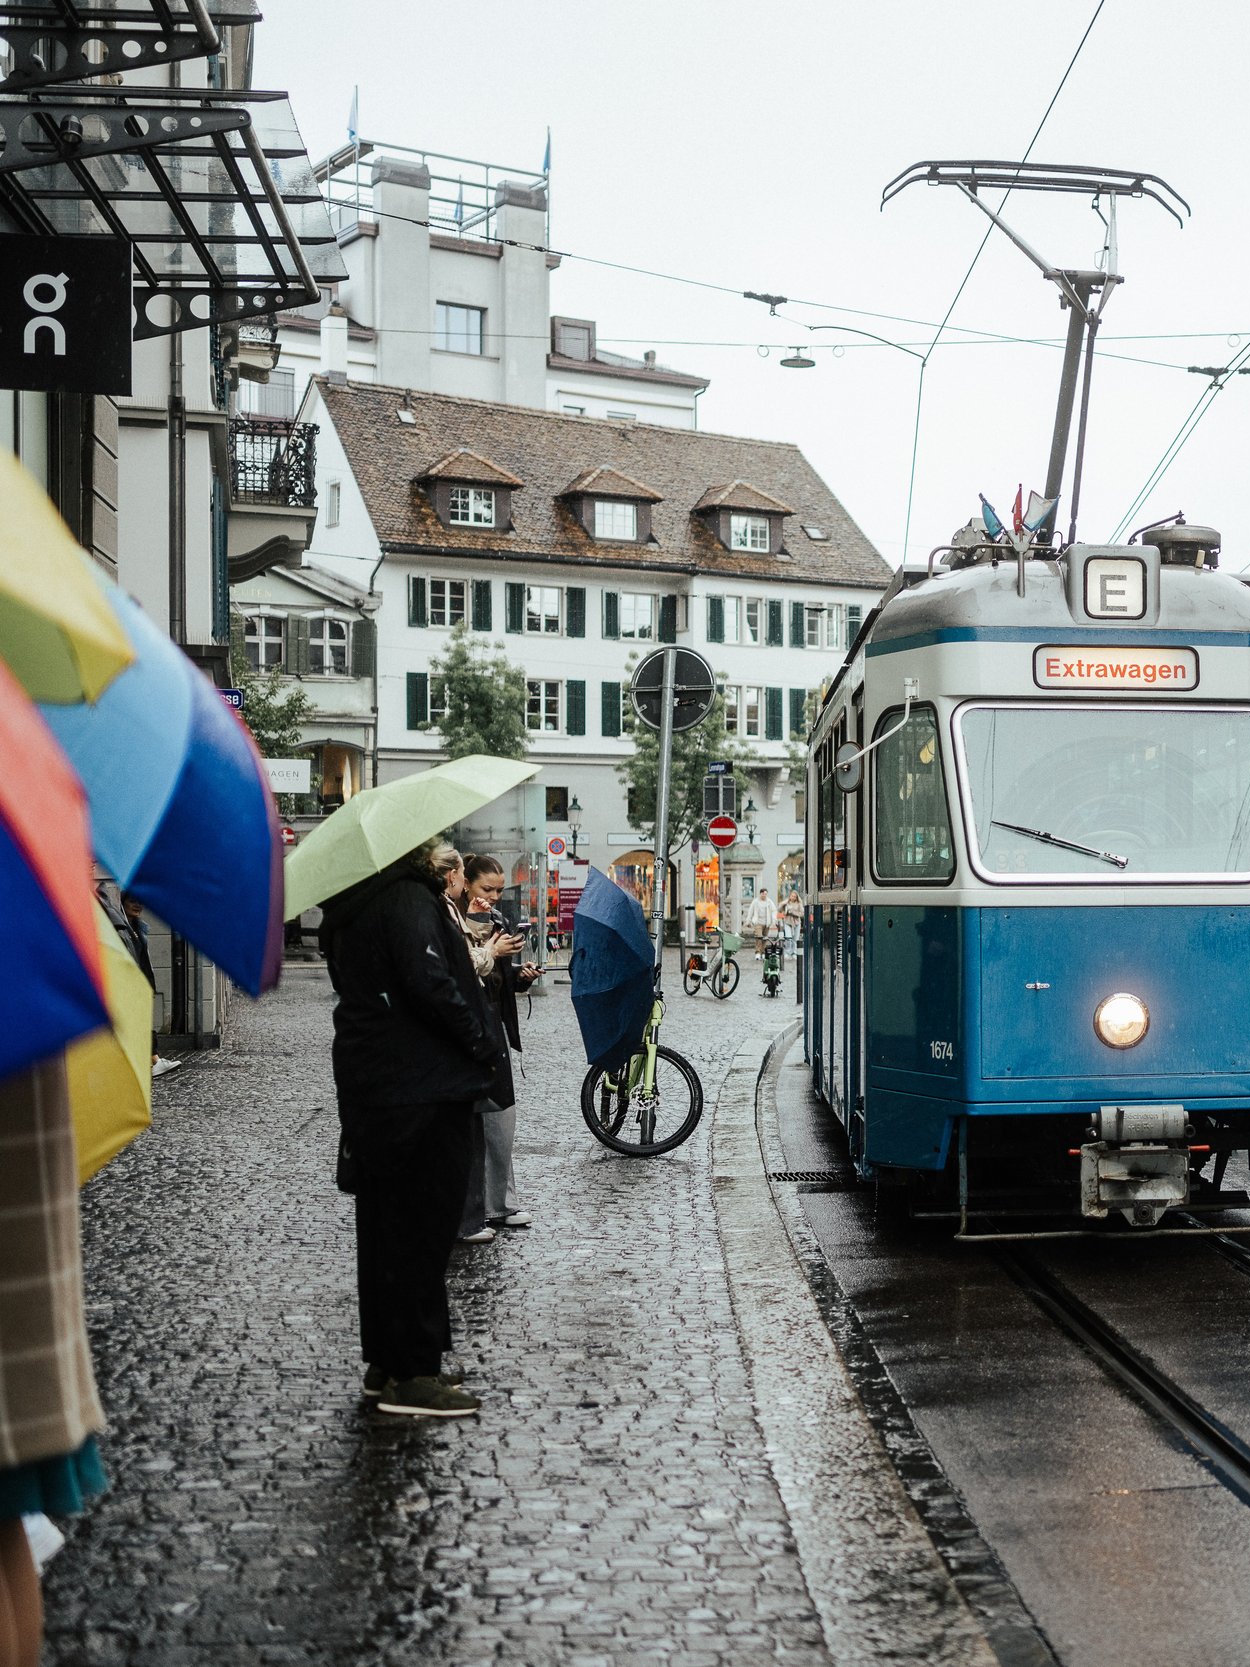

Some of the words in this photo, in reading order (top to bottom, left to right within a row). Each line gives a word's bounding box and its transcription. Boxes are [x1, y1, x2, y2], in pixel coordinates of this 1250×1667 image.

[1100, 574, 1128, 612] E
[1046, 658, 1186, 683] Extrawagen
[930, 1040, 954, 1060] 1674
